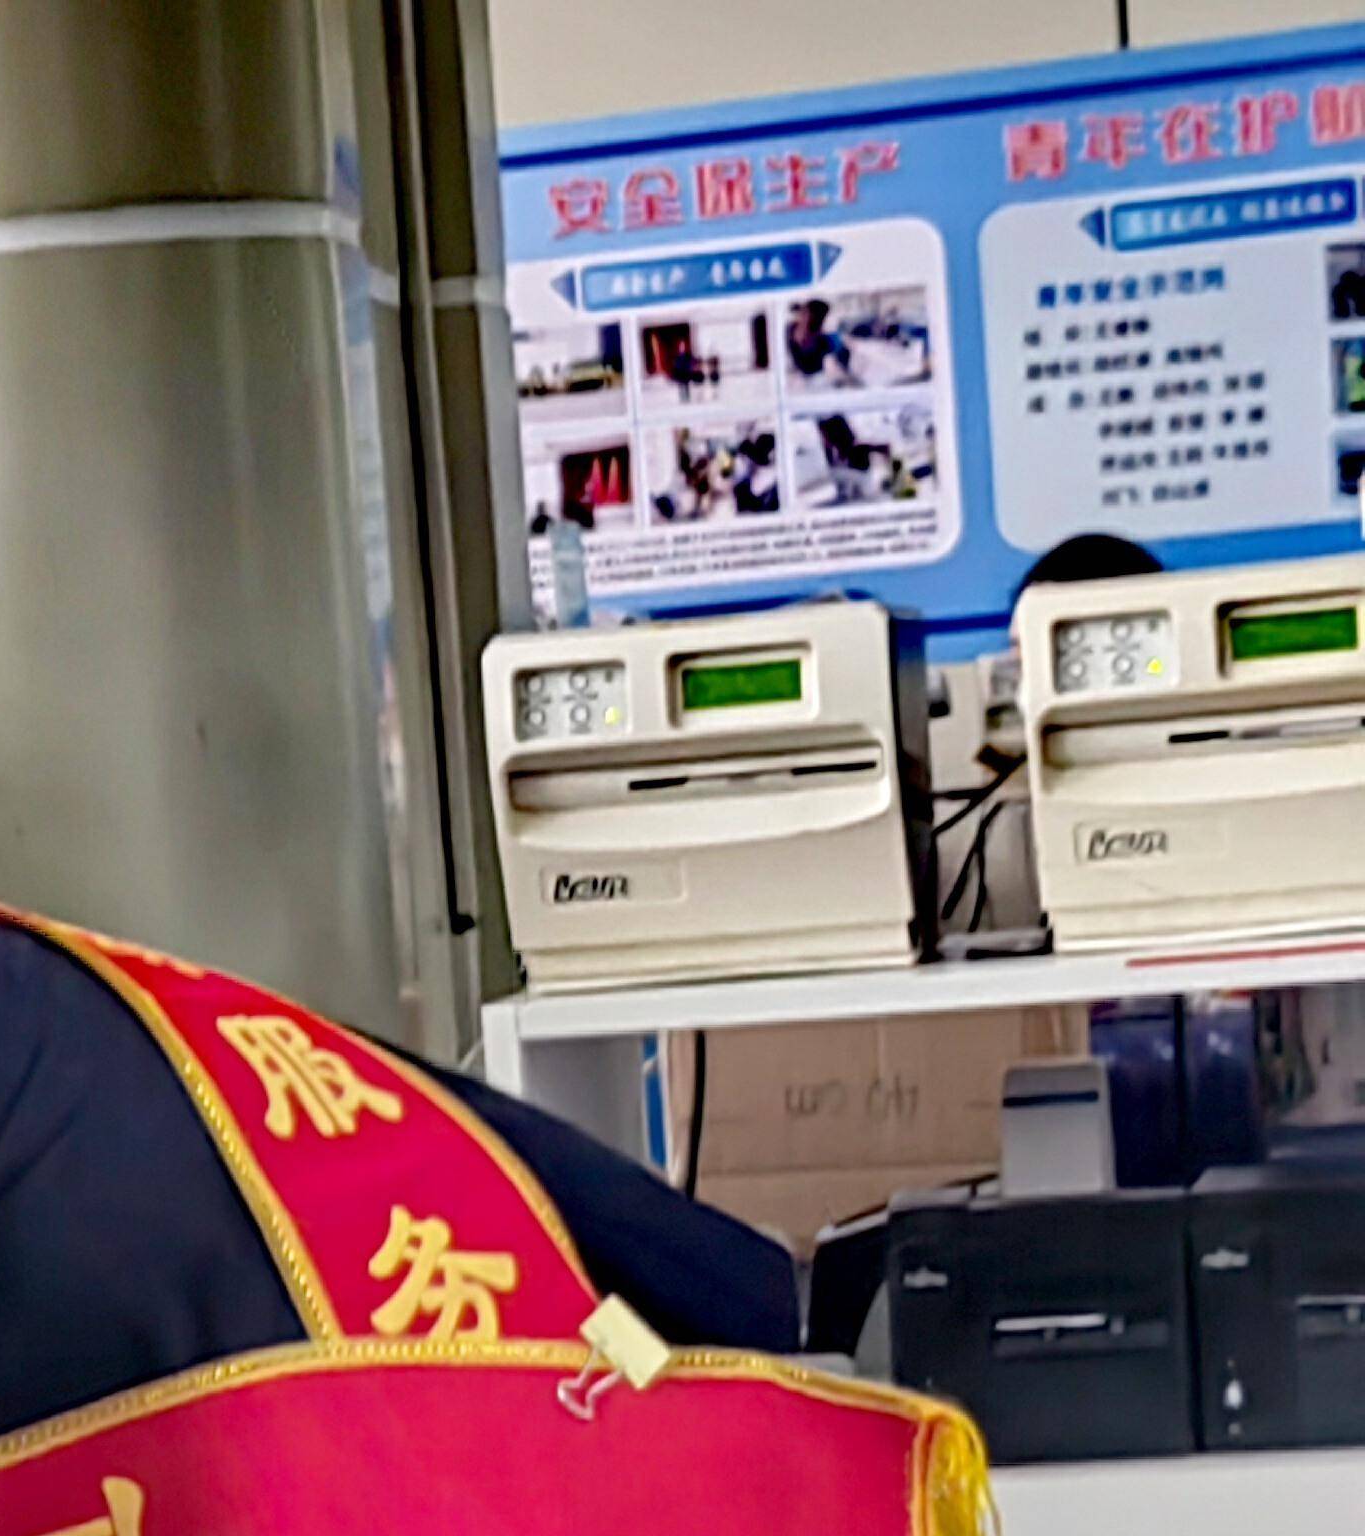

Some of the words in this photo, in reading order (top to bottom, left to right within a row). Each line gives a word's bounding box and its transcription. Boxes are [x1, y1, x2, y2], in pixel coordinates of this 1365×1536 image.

[549, 140, 899, 240] 安全保生产
